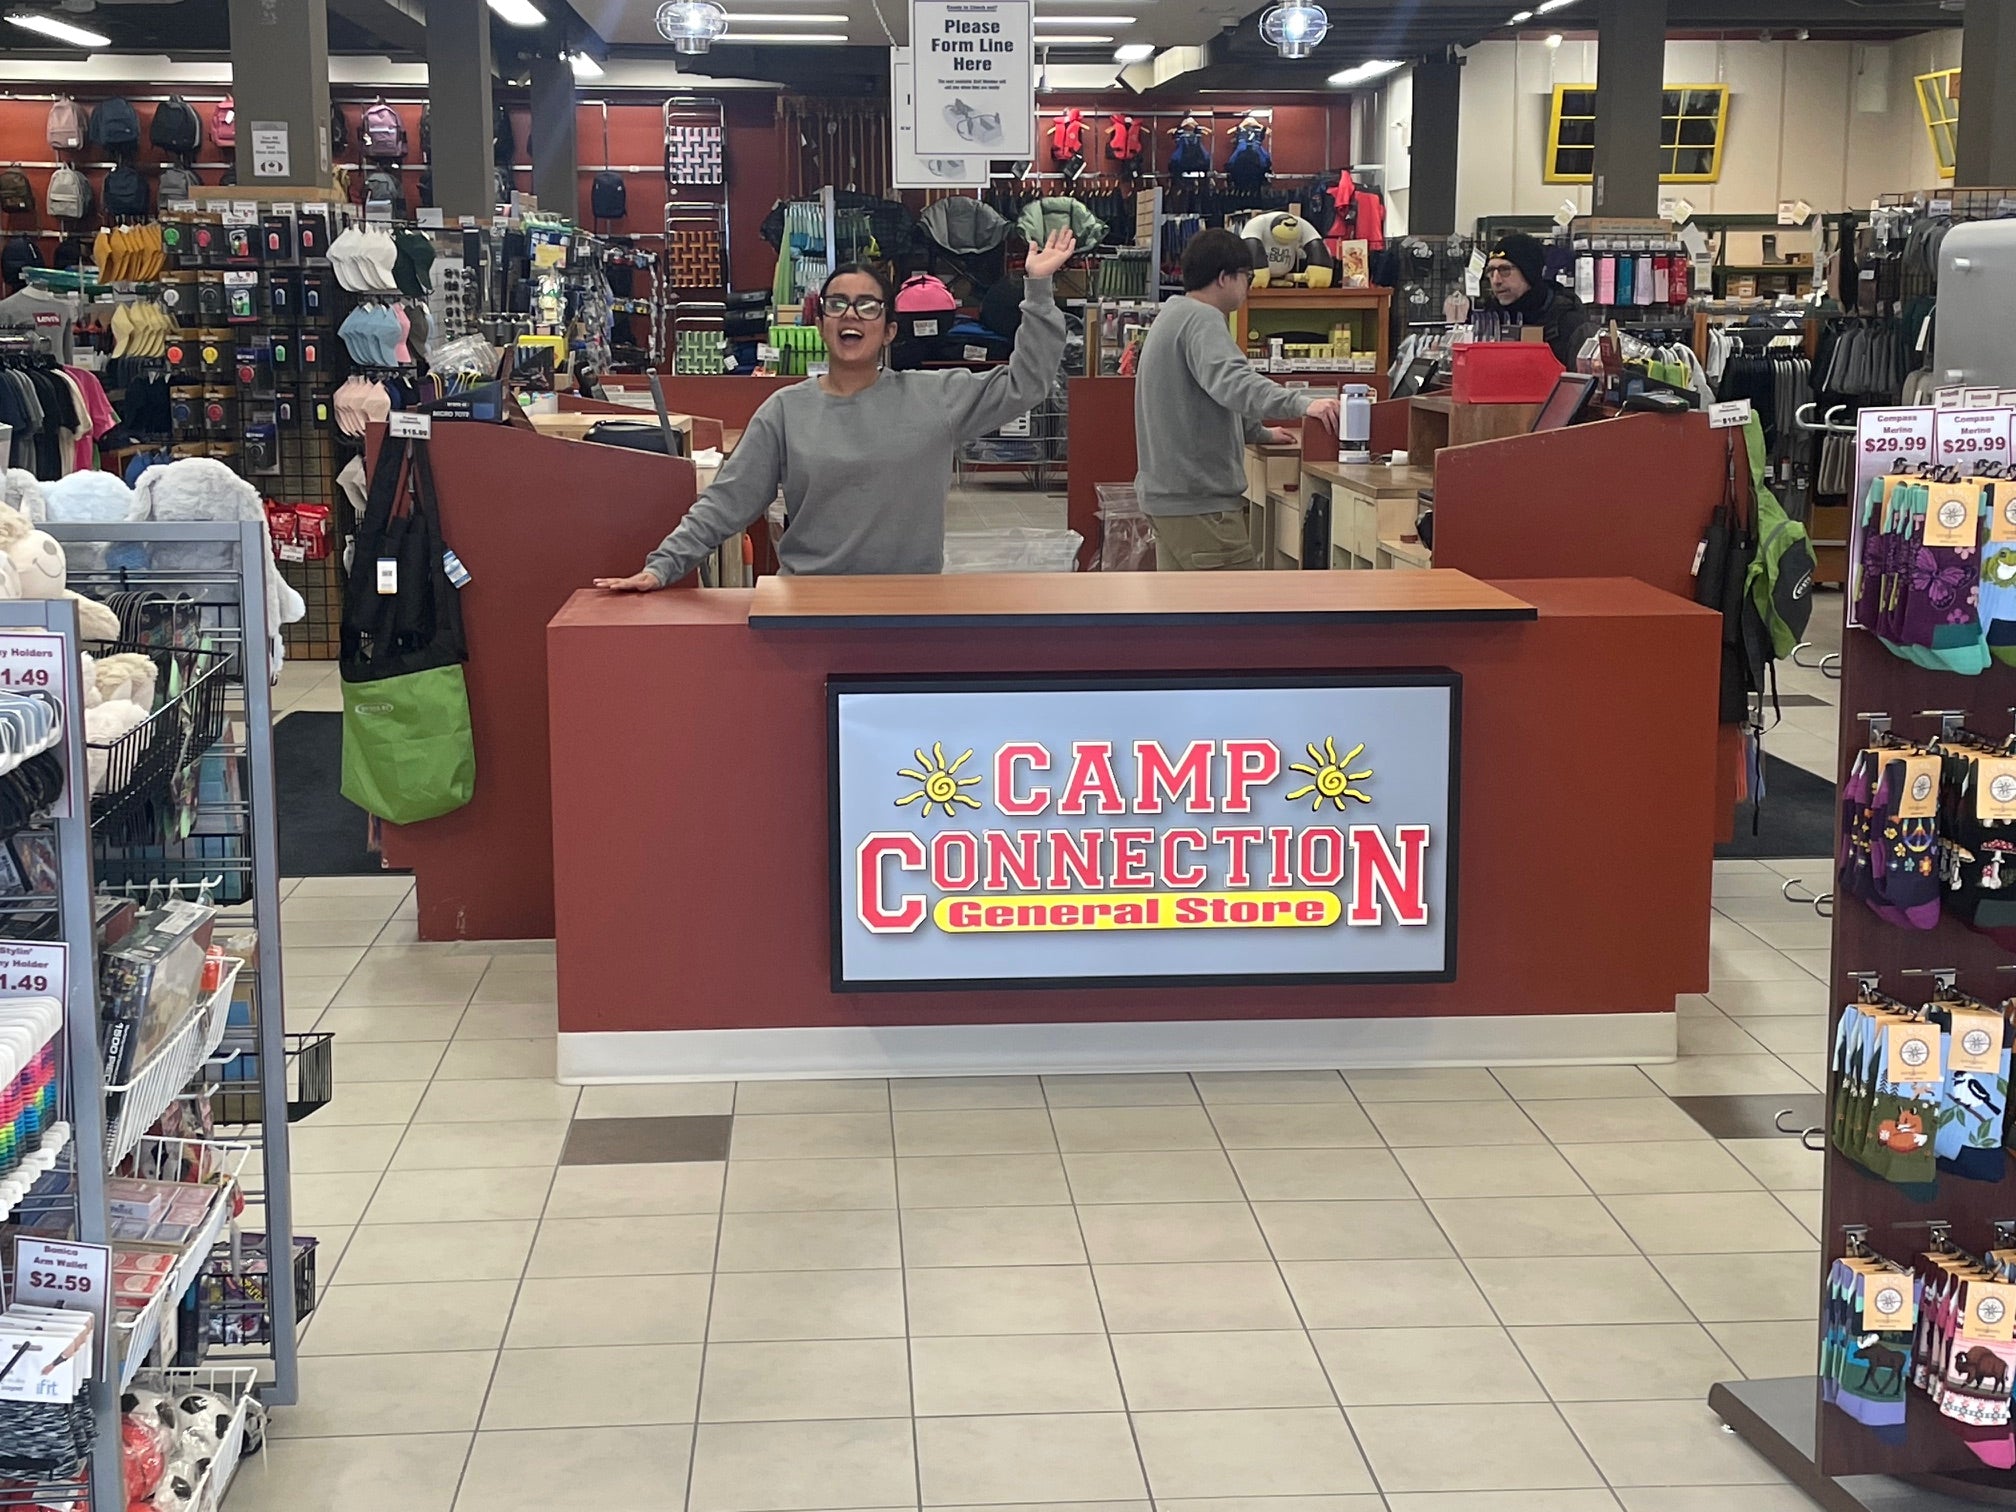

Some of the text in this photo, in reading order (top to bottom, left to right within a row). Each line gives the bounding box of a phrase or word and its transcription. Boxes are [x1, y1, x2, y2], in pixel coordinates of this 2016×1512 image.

[944, 19, 1000, 34] Please
[931, 38, 1014, 52] Form Line
[953, 56, 992, 71] Here
[1877, 415, 1917, 423] Compass
[1883, 426, 1913, 434] Merino
[1865, 436, 1927, 453] $29.99
[1943, 436, 2006, 453] $29.99
[11, 648, 53, 658] Holders
[993, 738, 1282, 817] CAMP
[855, 823, 1431, 934] CONNECTION
[948, 896, 1326, 927] General Store
[12, 959, 49, 969] Holder
[33, 1256, 88, 1270] Arm Wallet
[29, 1270, 92, 1293] $2.59
